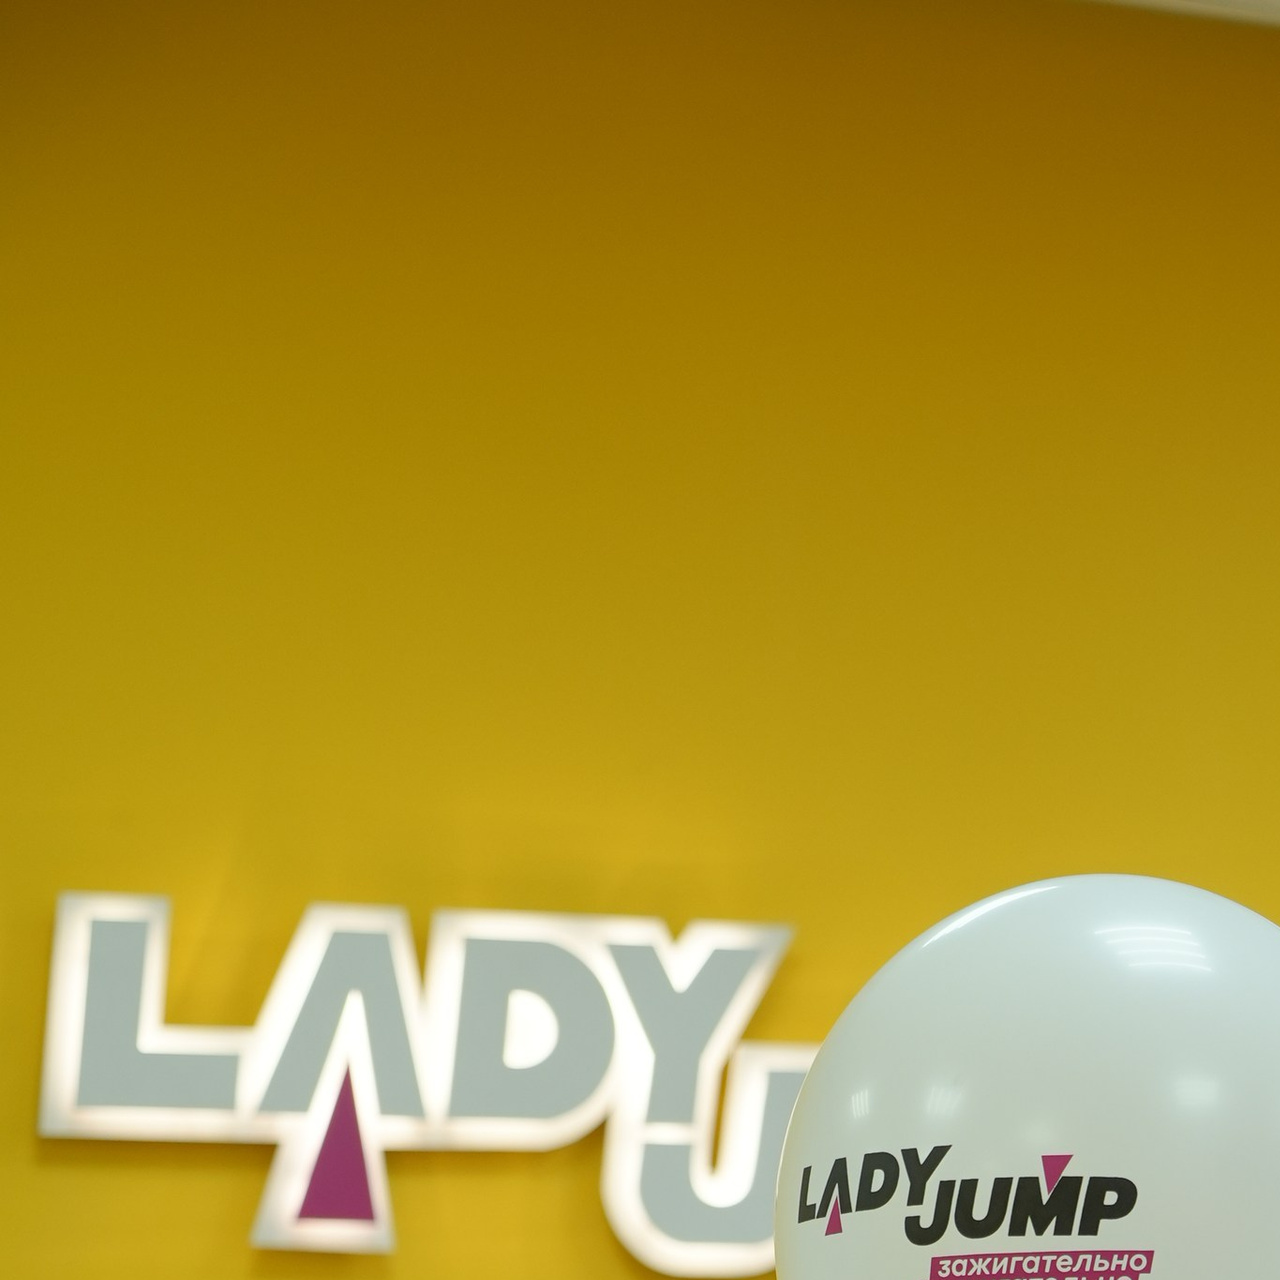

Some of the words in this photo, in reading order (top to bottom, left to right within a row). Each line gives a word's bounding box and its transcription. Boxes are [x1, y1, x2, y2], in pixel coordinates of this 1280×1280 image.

[75, 918, 761, 1221] LADY
[797, 1144, 953, 1237] LADY
[903, 1153, 1139, 1246] JUMP
[937, 1252, 1148, 1278] зажигательно
